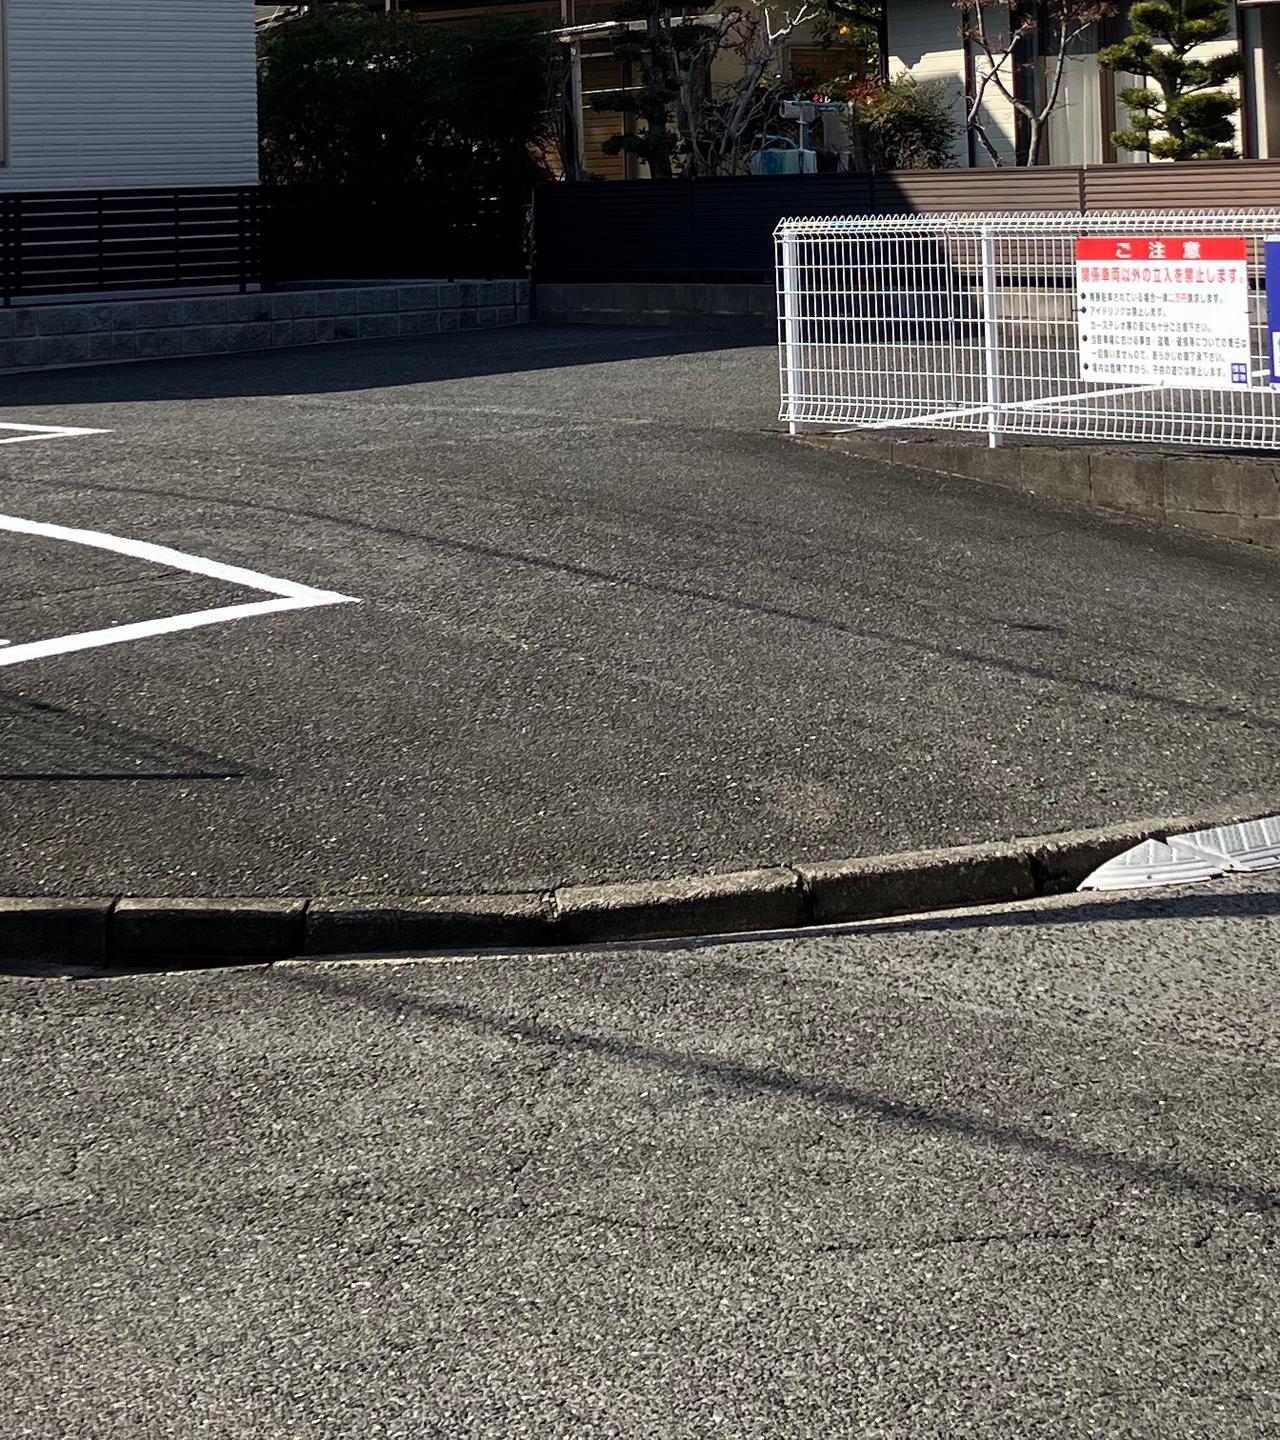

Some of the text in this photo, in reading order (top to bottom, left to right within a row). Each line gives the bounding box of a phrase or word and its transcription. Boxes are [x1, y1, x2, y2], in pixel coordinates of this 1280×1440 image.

[1115, 241, 1201, 259] ご注意
[1081, 267, 1244, 284] 関係車両以外の立入を禁止します。
